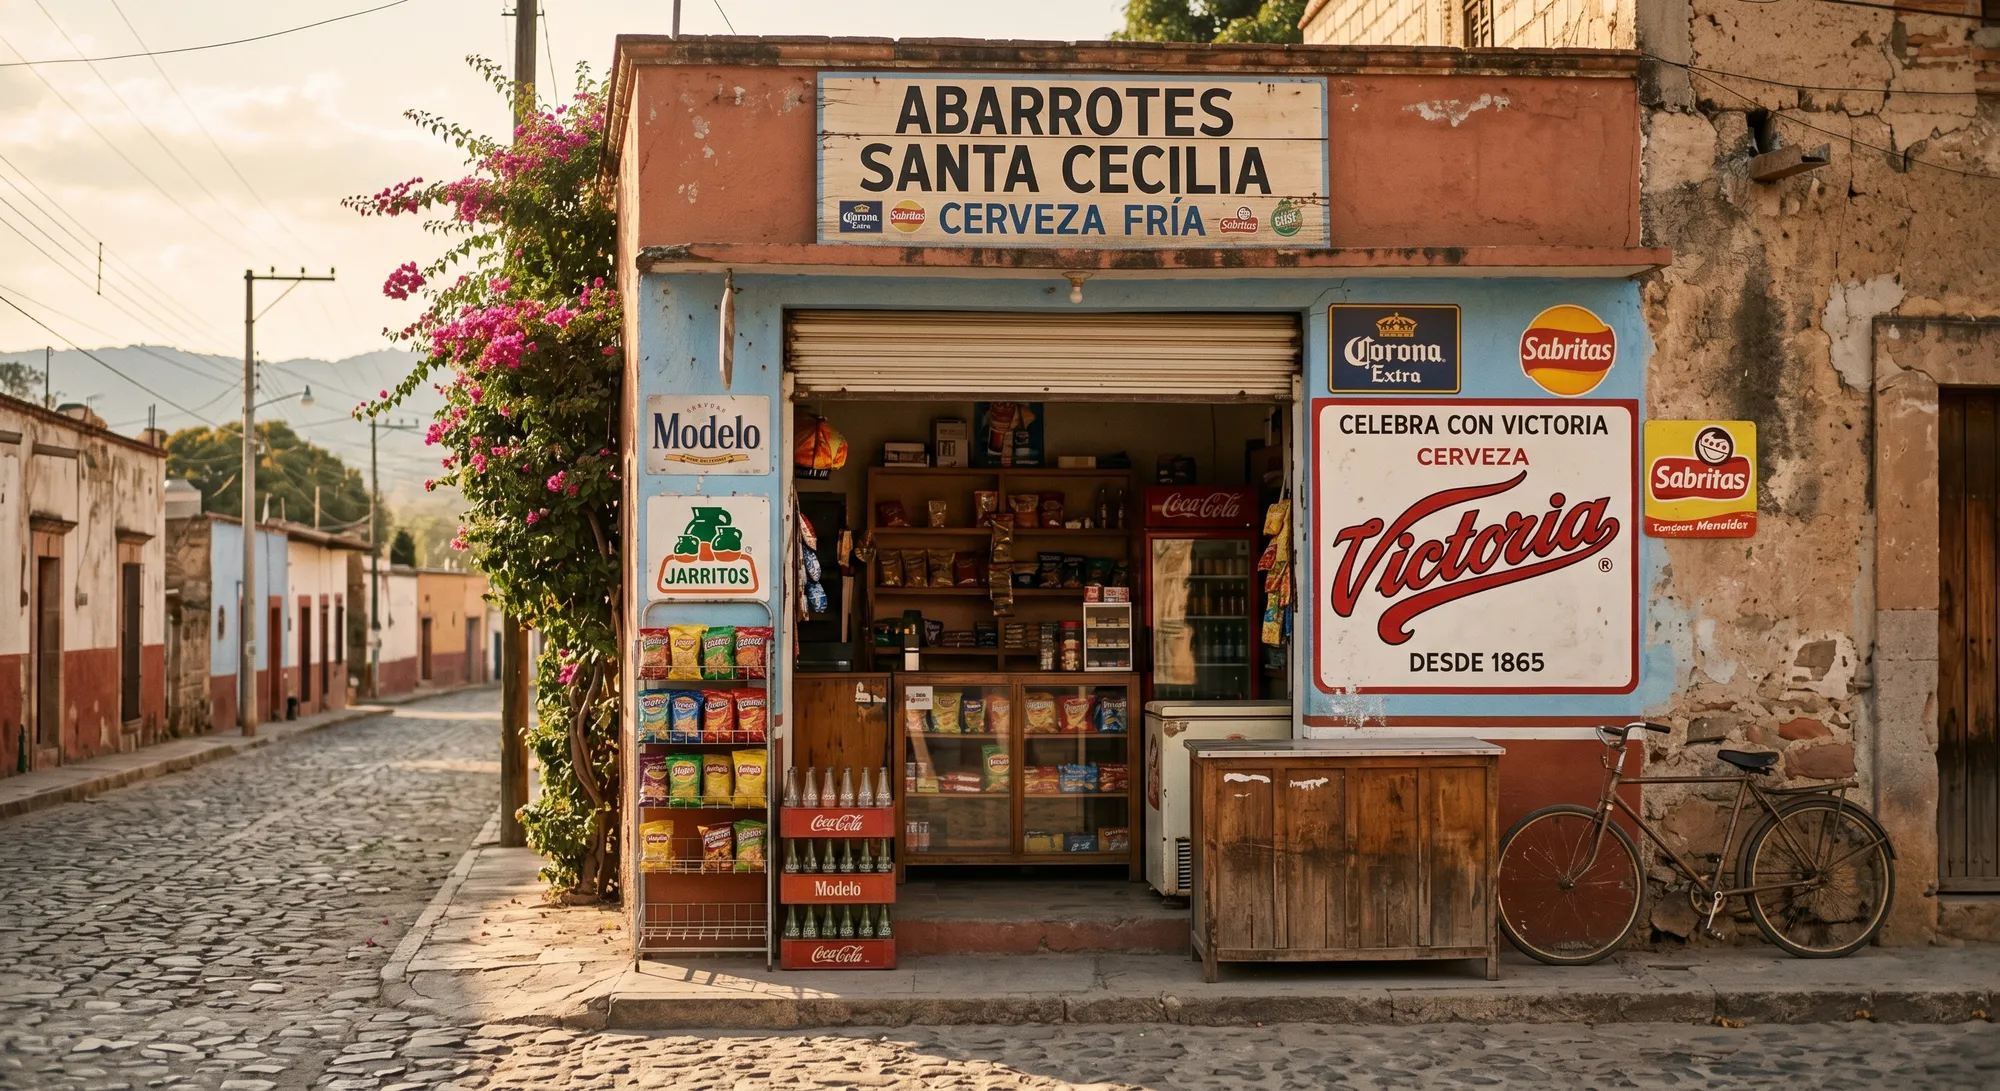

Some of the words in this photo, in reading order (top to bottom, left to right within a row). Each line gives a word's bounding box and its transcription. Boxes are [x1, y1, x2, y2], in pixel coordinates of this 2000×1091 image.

[894, 84, 1235, 136] ABARROTES
[859, 142, 1040, 193] SANTA
[1061, 144, 1273, 195] CECILIA
[843, 211, 879, 224] Corona
[891, 210, 925, 220] Sabritas
[939, 202, 1106, 236] CERVEZA
[1124, 197, 1207, 237] FRÍA
[1344, 335, 1446, 369] Corona
[1522, 337, 1613, 363] Sabritas
[1371, 364, 1422, 384] Extra
[652, 412, 761, 450] Modelo
[1339, 414, 1440, 436] CELEBRA
[1447, 414, 1493, 436] CON
[1501, 414, 1609, 436] VICTORIA
[1416, 447, 1530, 466] CERVEZA
[1655, 464, 1747, 493] Sabritas
[1331, 470, 1620, 645] Victoria
[664, 567, 750, 585] JARRITOS
[1409, 652, 1484, 673] DESDE
[1491, 652, 1546, 673] 1865
[815, 880, 861, 897] Modelo
